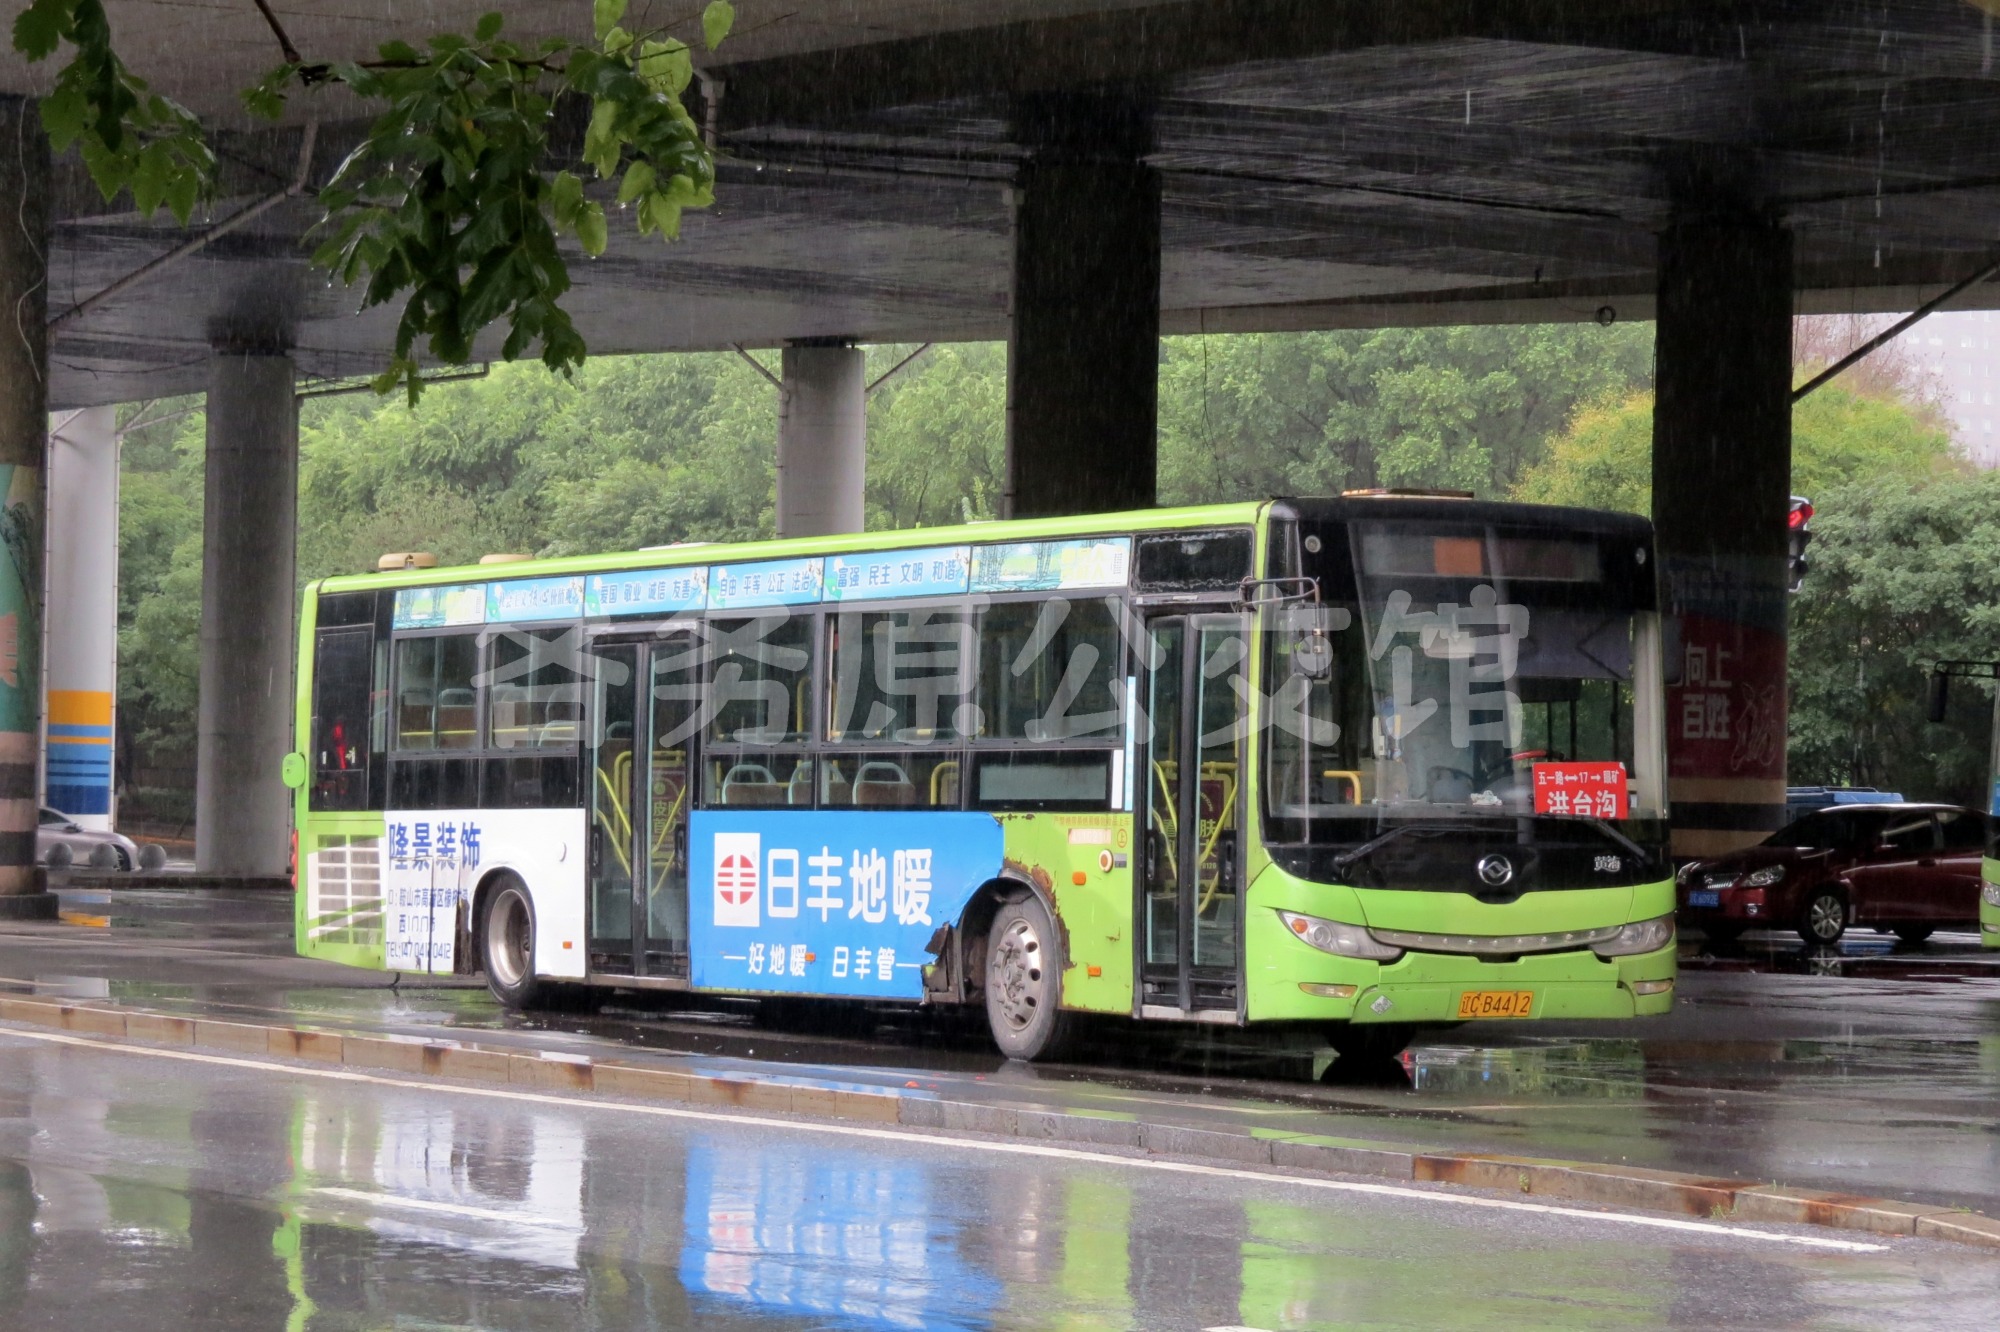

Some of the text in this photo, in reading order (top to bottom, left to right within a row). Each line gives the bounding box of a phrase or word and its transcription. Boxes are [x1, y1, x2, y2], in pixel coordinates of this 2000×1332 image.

[720, 570, 810, 597] 自由 平等 公正 法治
[837, 560, 957, 587] 富强 民主 文明 和谐
[600, 579, 691, 604] 爱国 敬业 诚信 友善
[1538, 771, 1564, 785] 五一路
[1579, 772, 1588, 784] 17
[1547, 790, 1616, 818] 洪台沟
[389, 821, 482, 872] 隆景装饰
[767, 846, 933, 926] 日丰地暖
